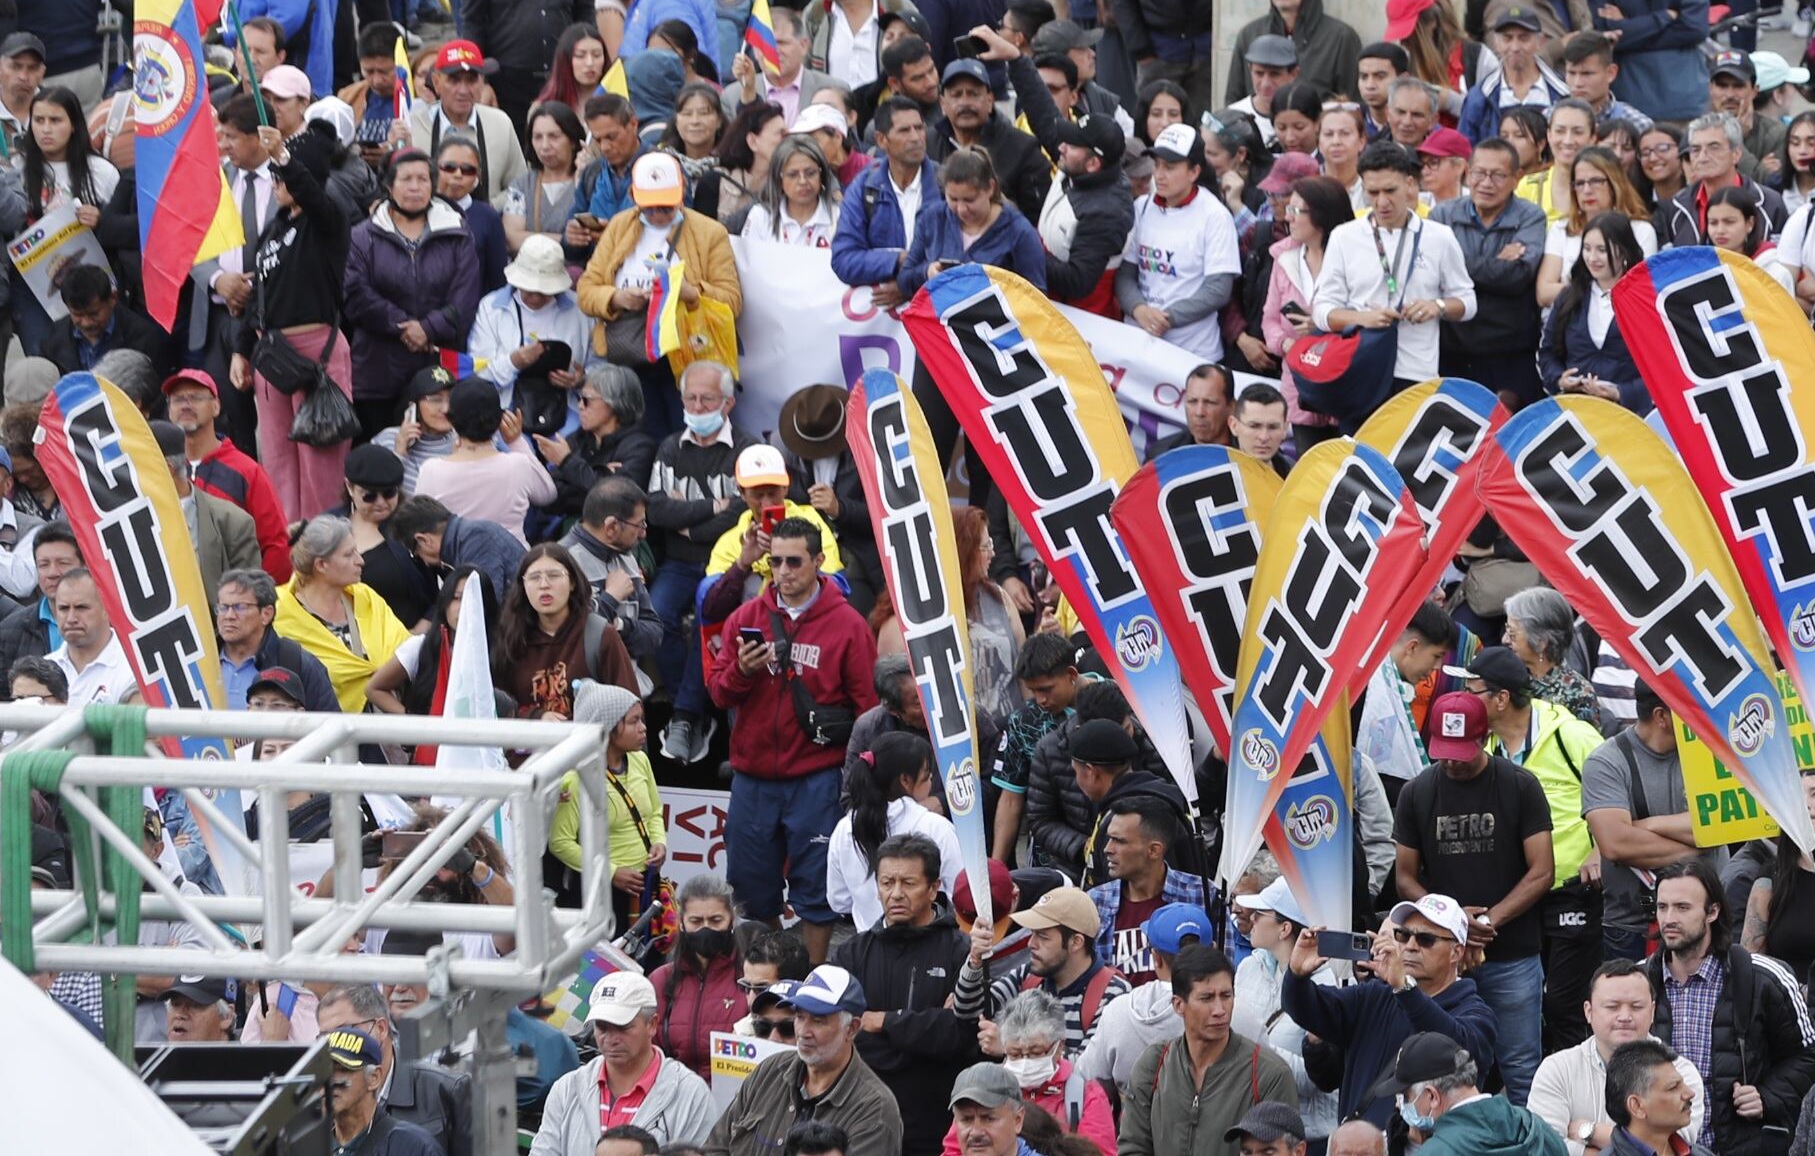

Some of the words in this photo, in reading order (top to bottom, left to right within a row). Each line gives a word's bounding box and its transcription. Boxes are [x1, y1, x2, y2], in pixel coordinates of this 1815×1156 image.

[68, 401, 201, 710] CUT
[872, 405, 968, 745] CUT
[947, 294, 1140, 606] CUT
[1522, 422, 1743, 698] CUT
[1258, 463, 1399, 726] CUT
[1437, 813, 1495, 840] PETRO
[715, 1037, 756, 1059] PETRO
